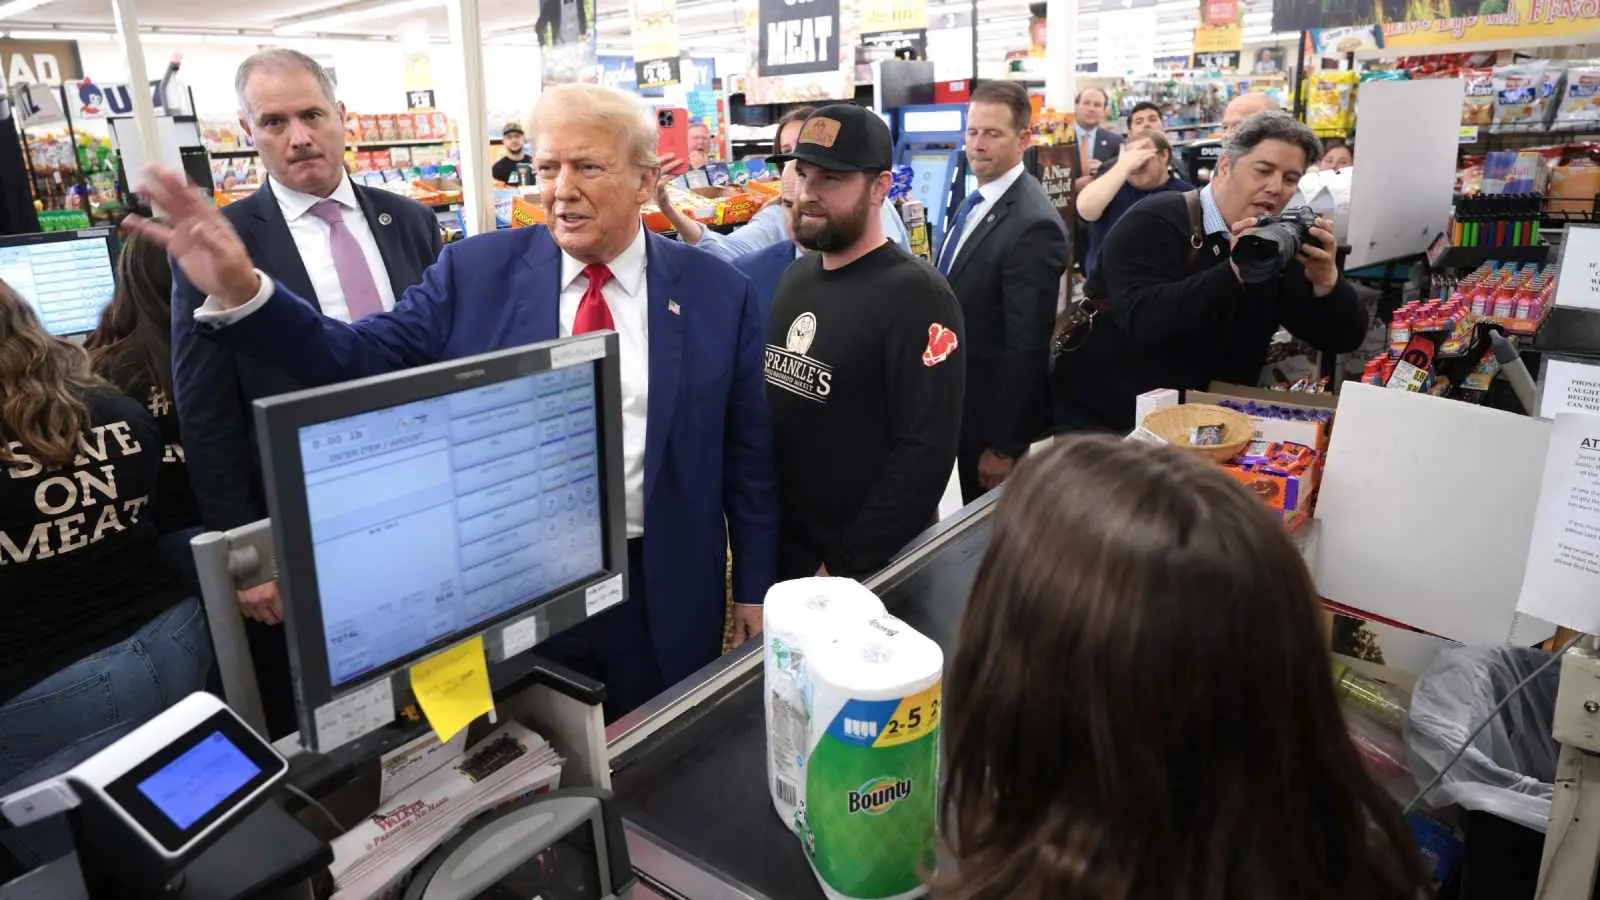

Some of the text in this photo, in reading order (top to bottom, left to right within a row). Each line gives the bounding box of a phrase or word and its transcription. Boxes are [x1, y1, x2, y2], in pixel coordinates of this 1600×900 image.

[767, 16, 833, 66] MEAT
[0, 52, 62, 88] AD
[8, 420, 143, 480] SVE
[34, 464, 119, 516] ON
[0, 495, 149, 566] MEAT
[331, 631, 360, 645] TOTAL
[848, 778, 912, 815] Bounty
